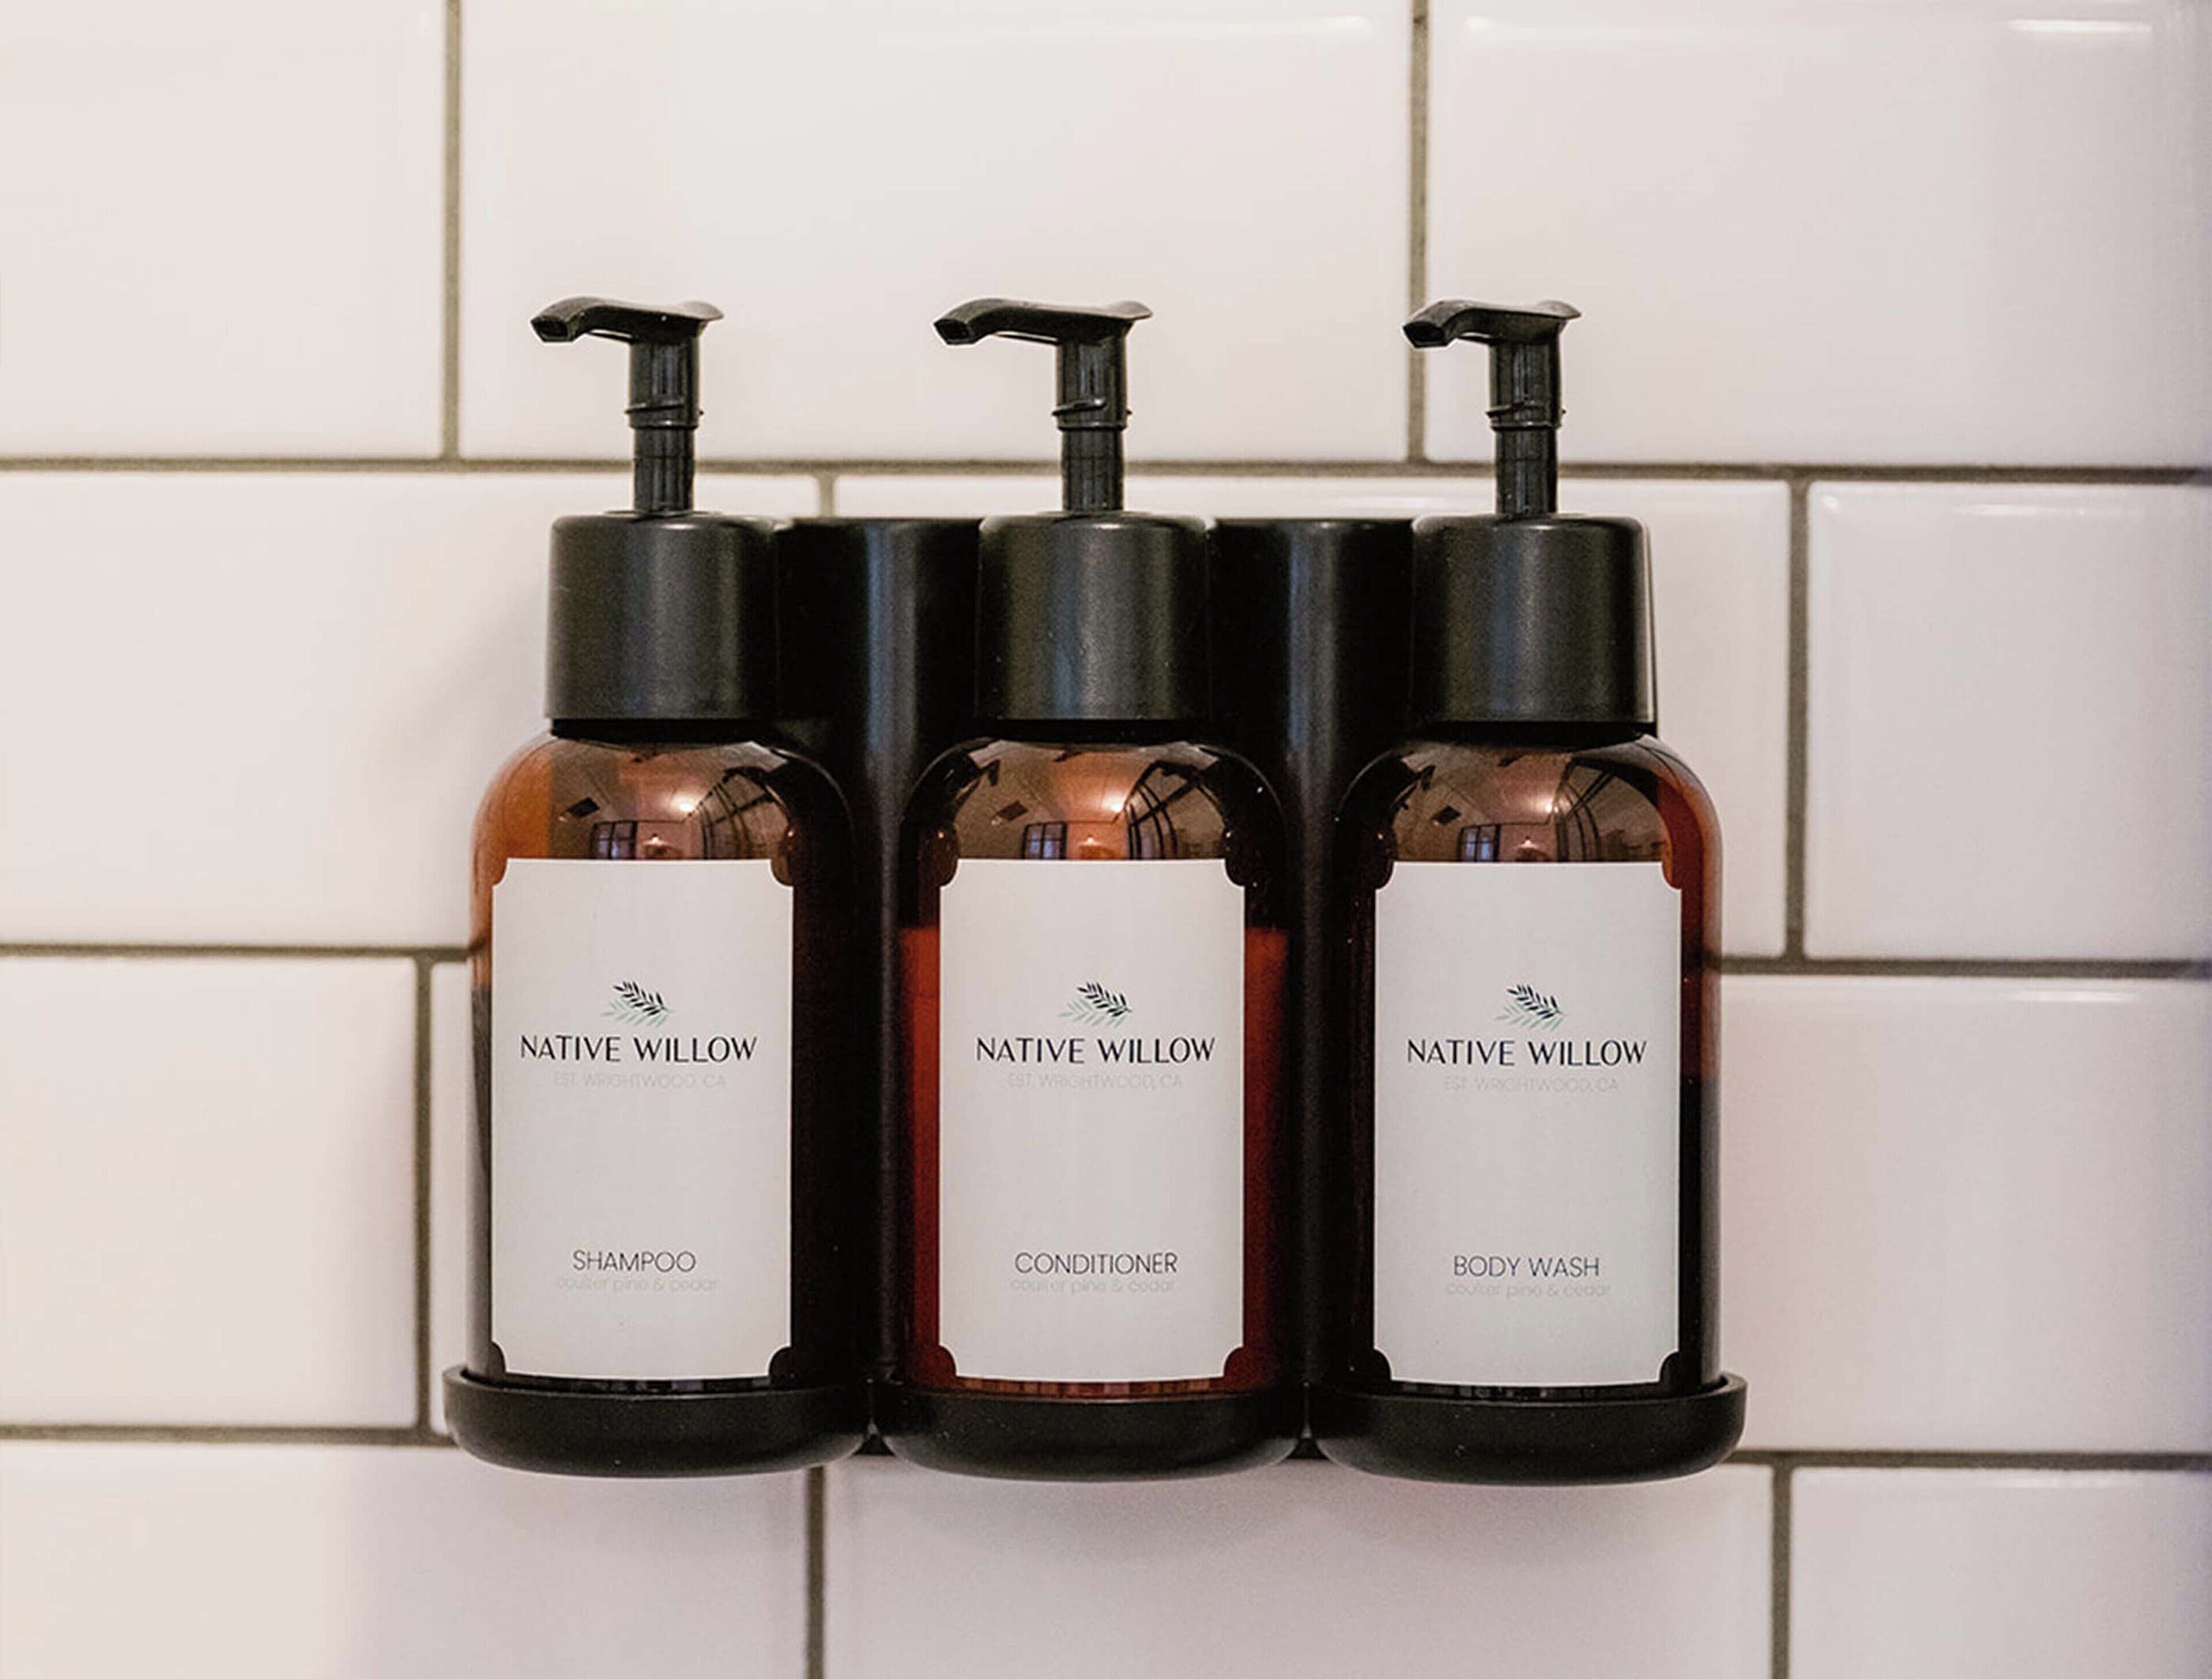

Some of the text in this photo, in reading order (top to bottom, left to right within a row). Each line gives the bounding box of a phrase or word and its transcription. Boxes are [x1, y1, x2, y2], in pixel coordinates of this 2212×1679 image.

[520, 1034, 757, 1063] NATIVE WILLOW
[976, 1037, 1215, 1064] NATIVE WILLOW
[1407, 1038, 1647, 1067] NATIVE WILLOW
[702, 1073, 726, 1088] CA
[1160, 1074, 1183, 1089] CA
[573, 1249, 698, 1273] SHAMPOO
[1014, 1251, 1179, 1275] CONDITIONER
[1453, 1255, 1600, 1278] BODY WASH
[1547, 1284, 1559, 1297] &
